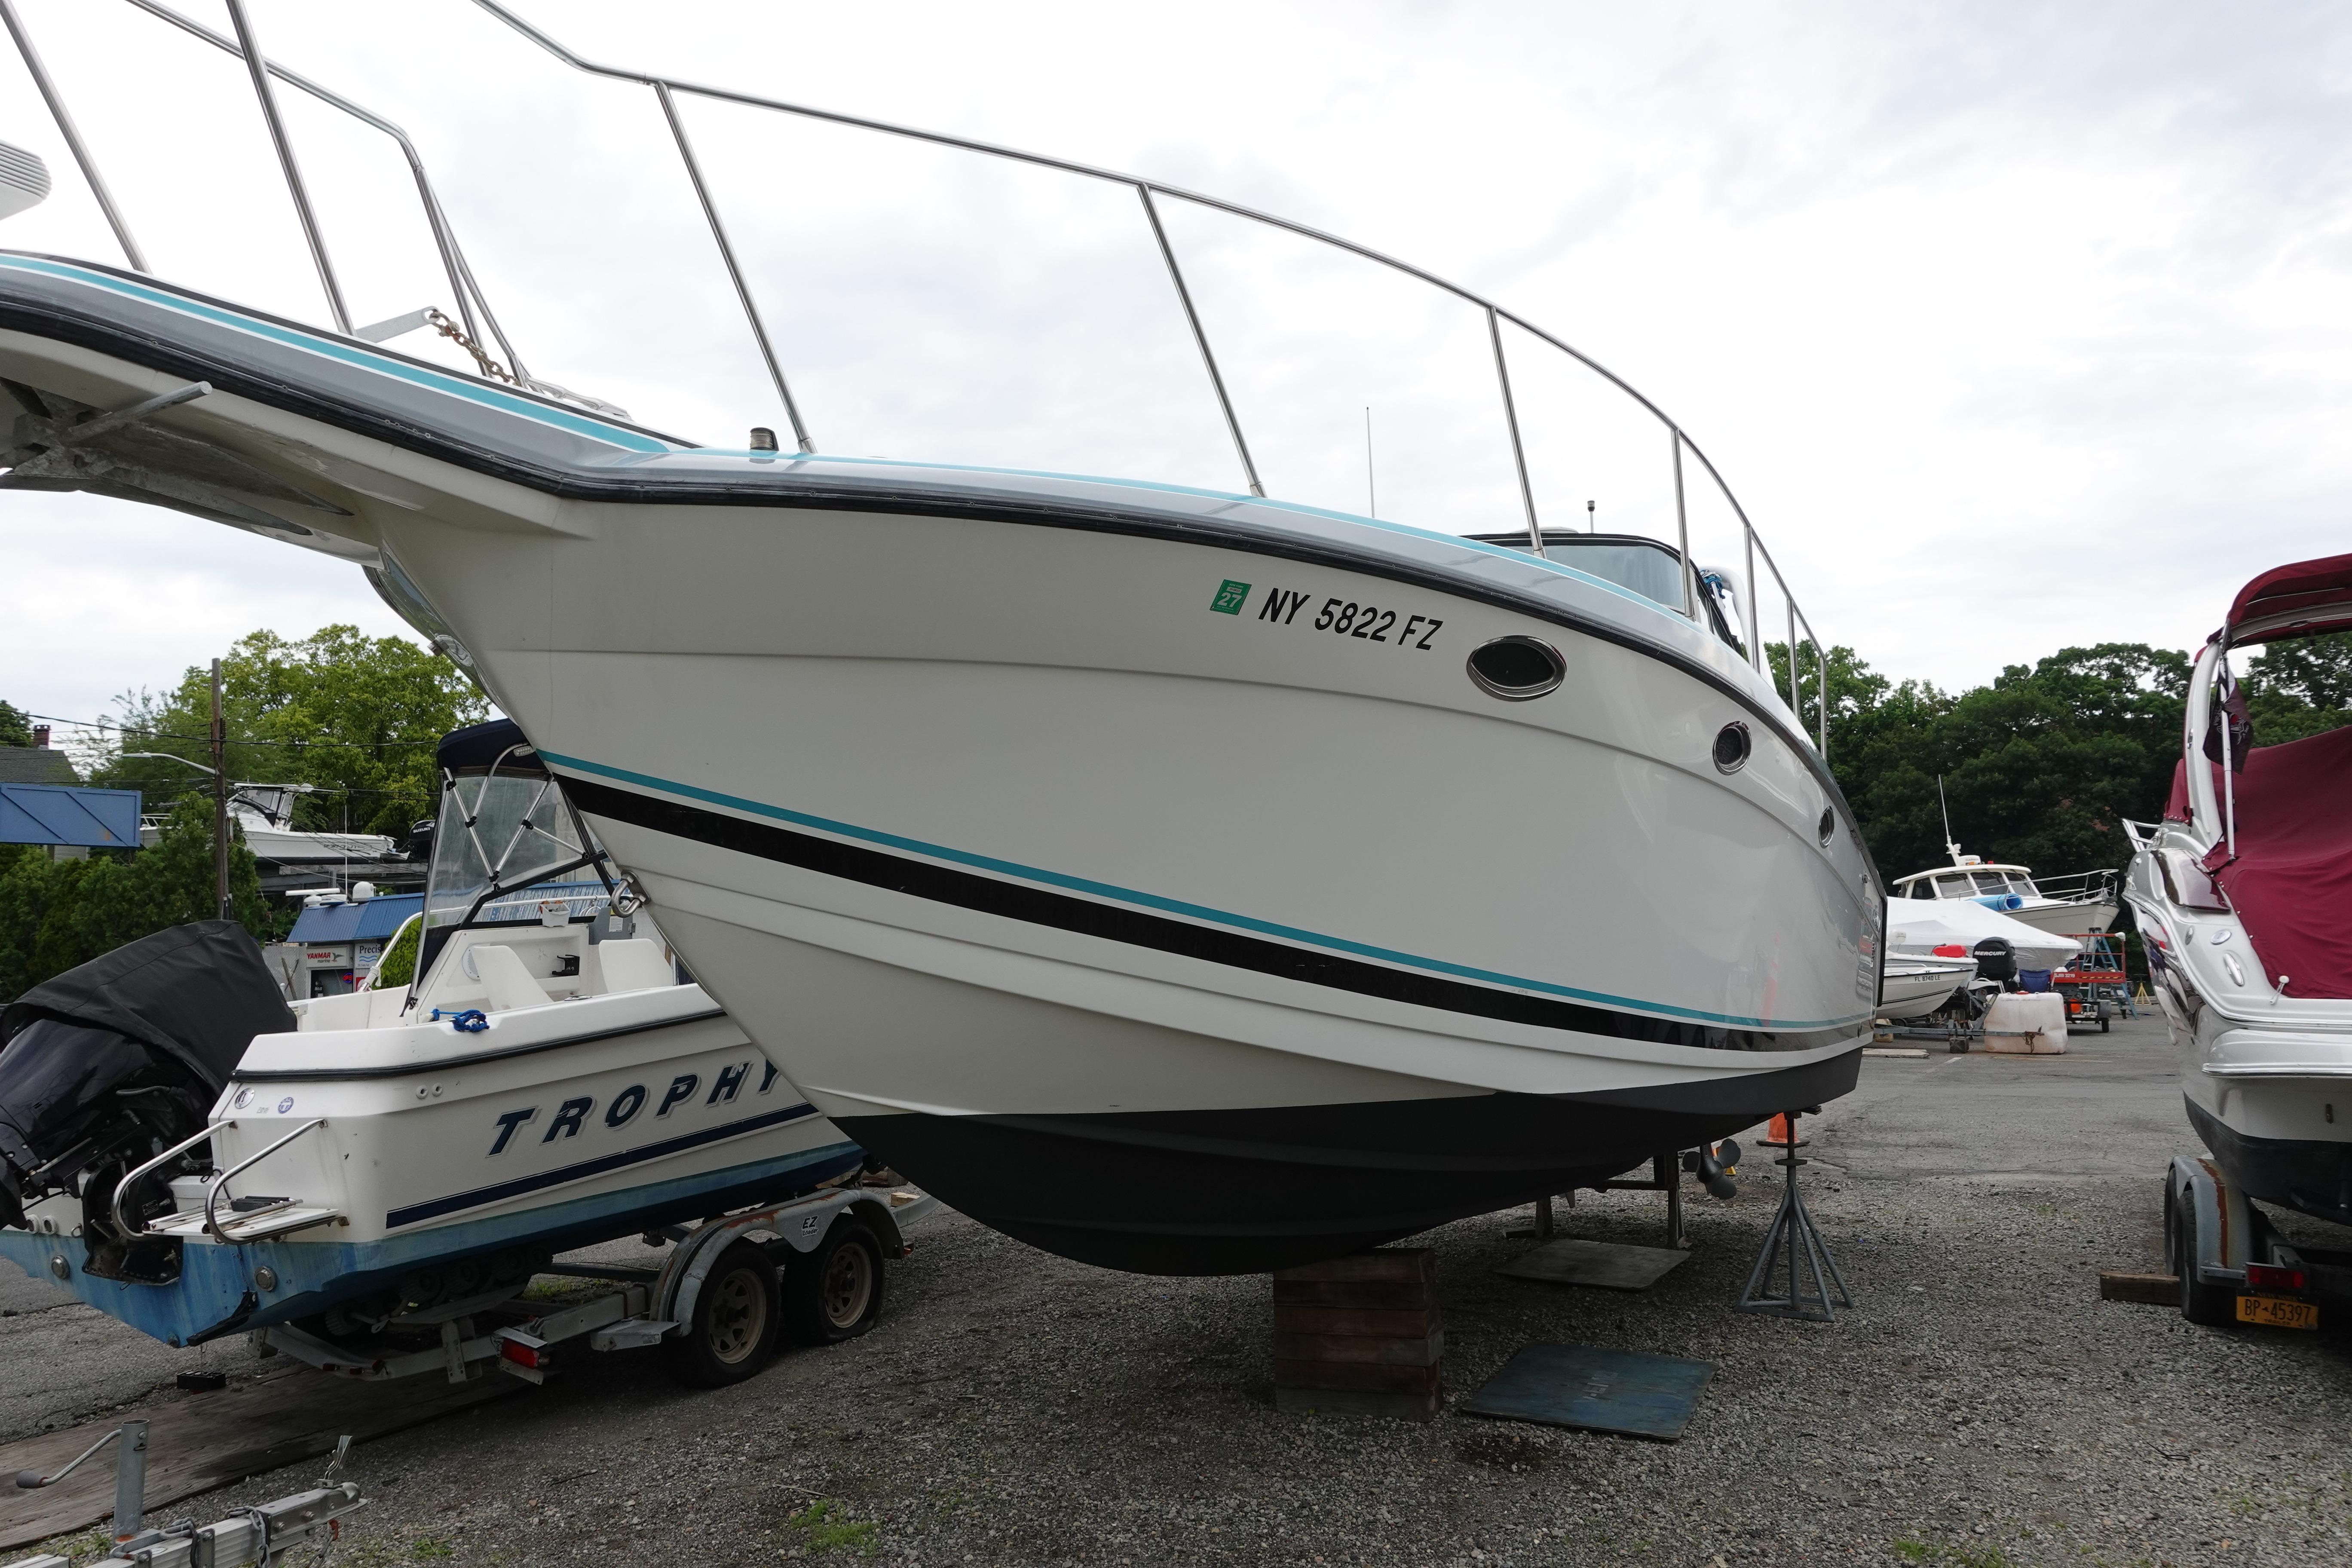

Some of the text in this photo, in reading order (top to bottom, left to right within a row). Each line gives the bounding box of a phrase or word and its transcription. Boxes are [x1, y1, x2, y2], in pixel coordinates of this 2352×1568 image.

[1217, 592, 1242, 608] 27
[1258, 588, 1443, 651] NY 5822 FZ
[802, 1216, 818, 1229] EZ
[802, 1228, 818, 1236] Loader
[2245, 1298, 2311, 1326] BP 45397
